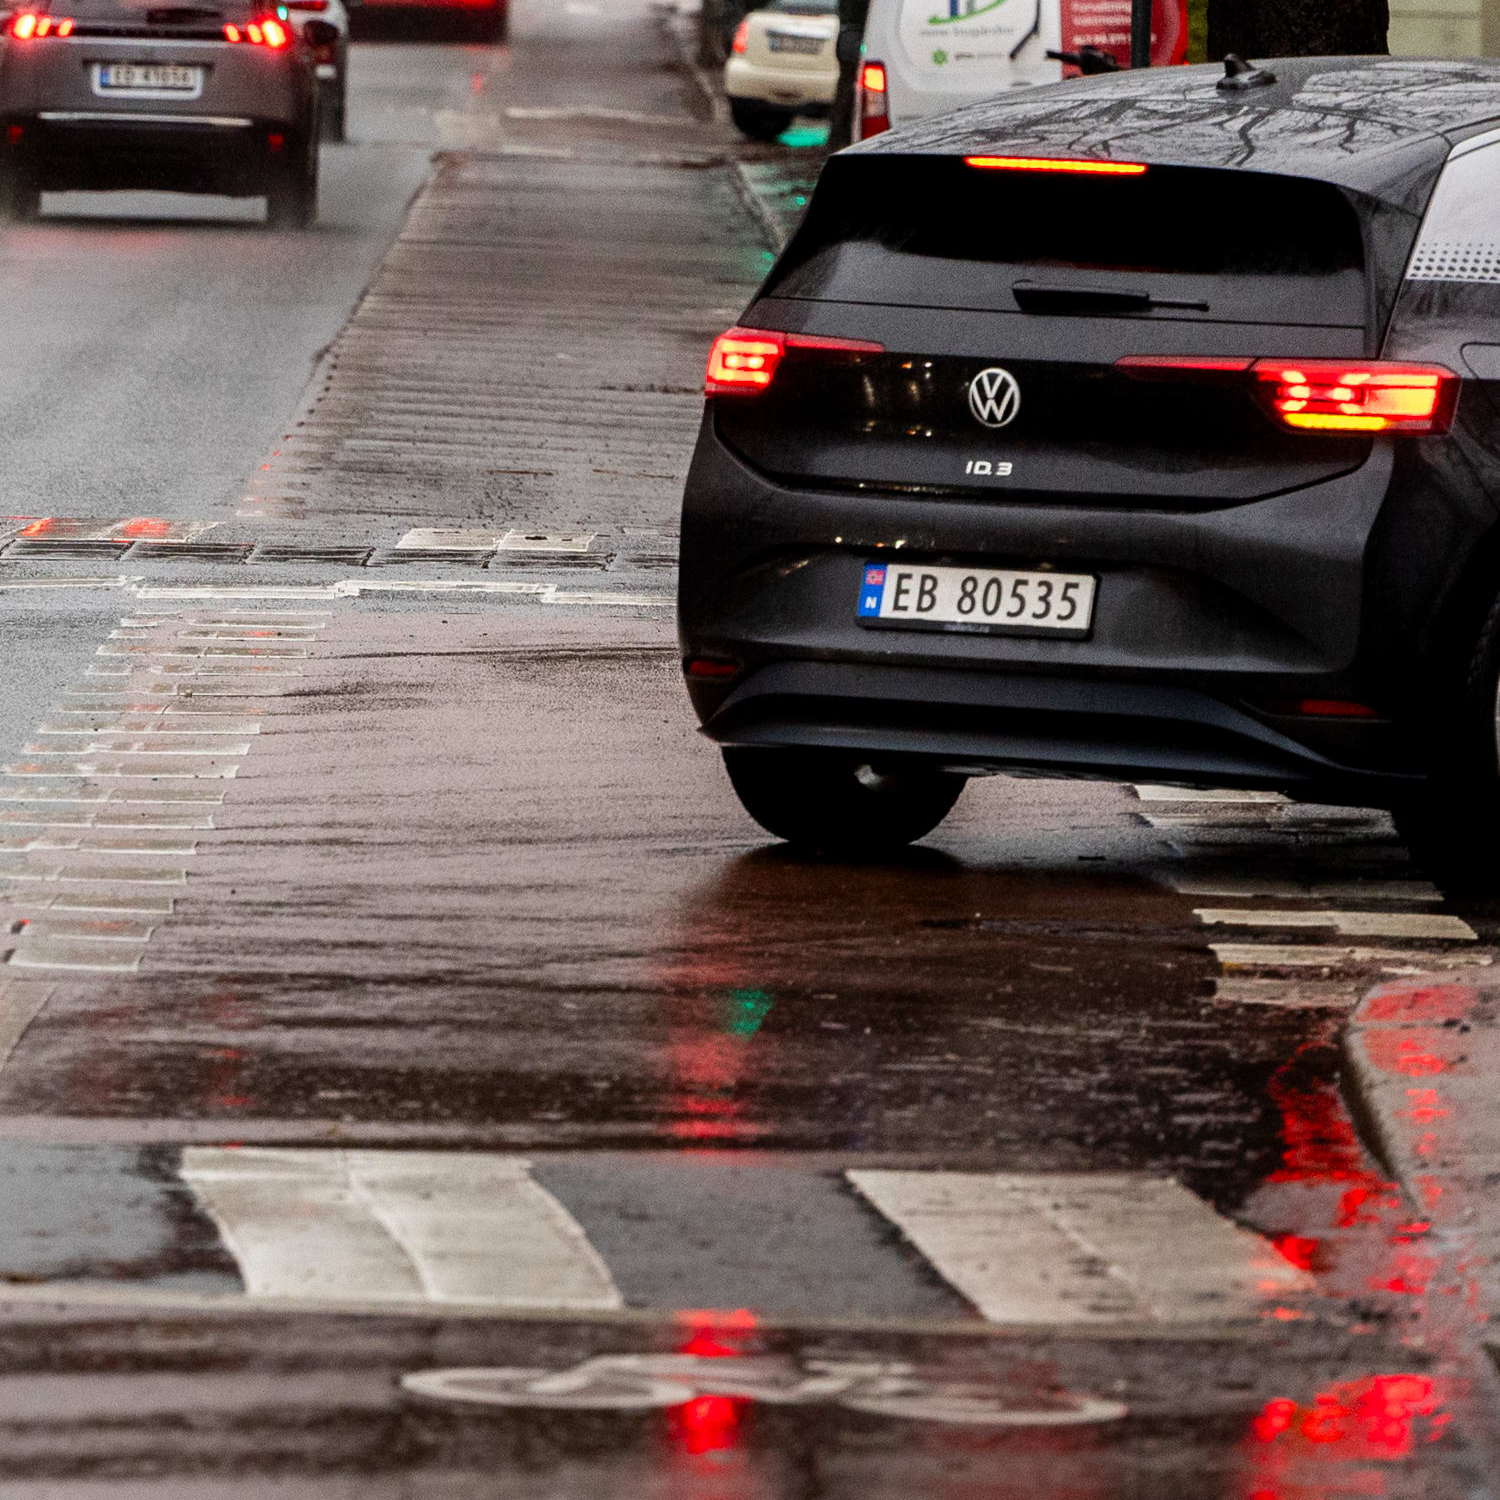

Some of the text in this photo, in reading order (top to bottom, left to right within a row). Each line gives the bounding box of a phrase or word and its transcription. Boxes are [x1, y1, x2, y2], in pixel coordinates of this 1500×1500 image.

[865, 595, 877, 609] N
[892, 572, 1080, 621] EB 80535
